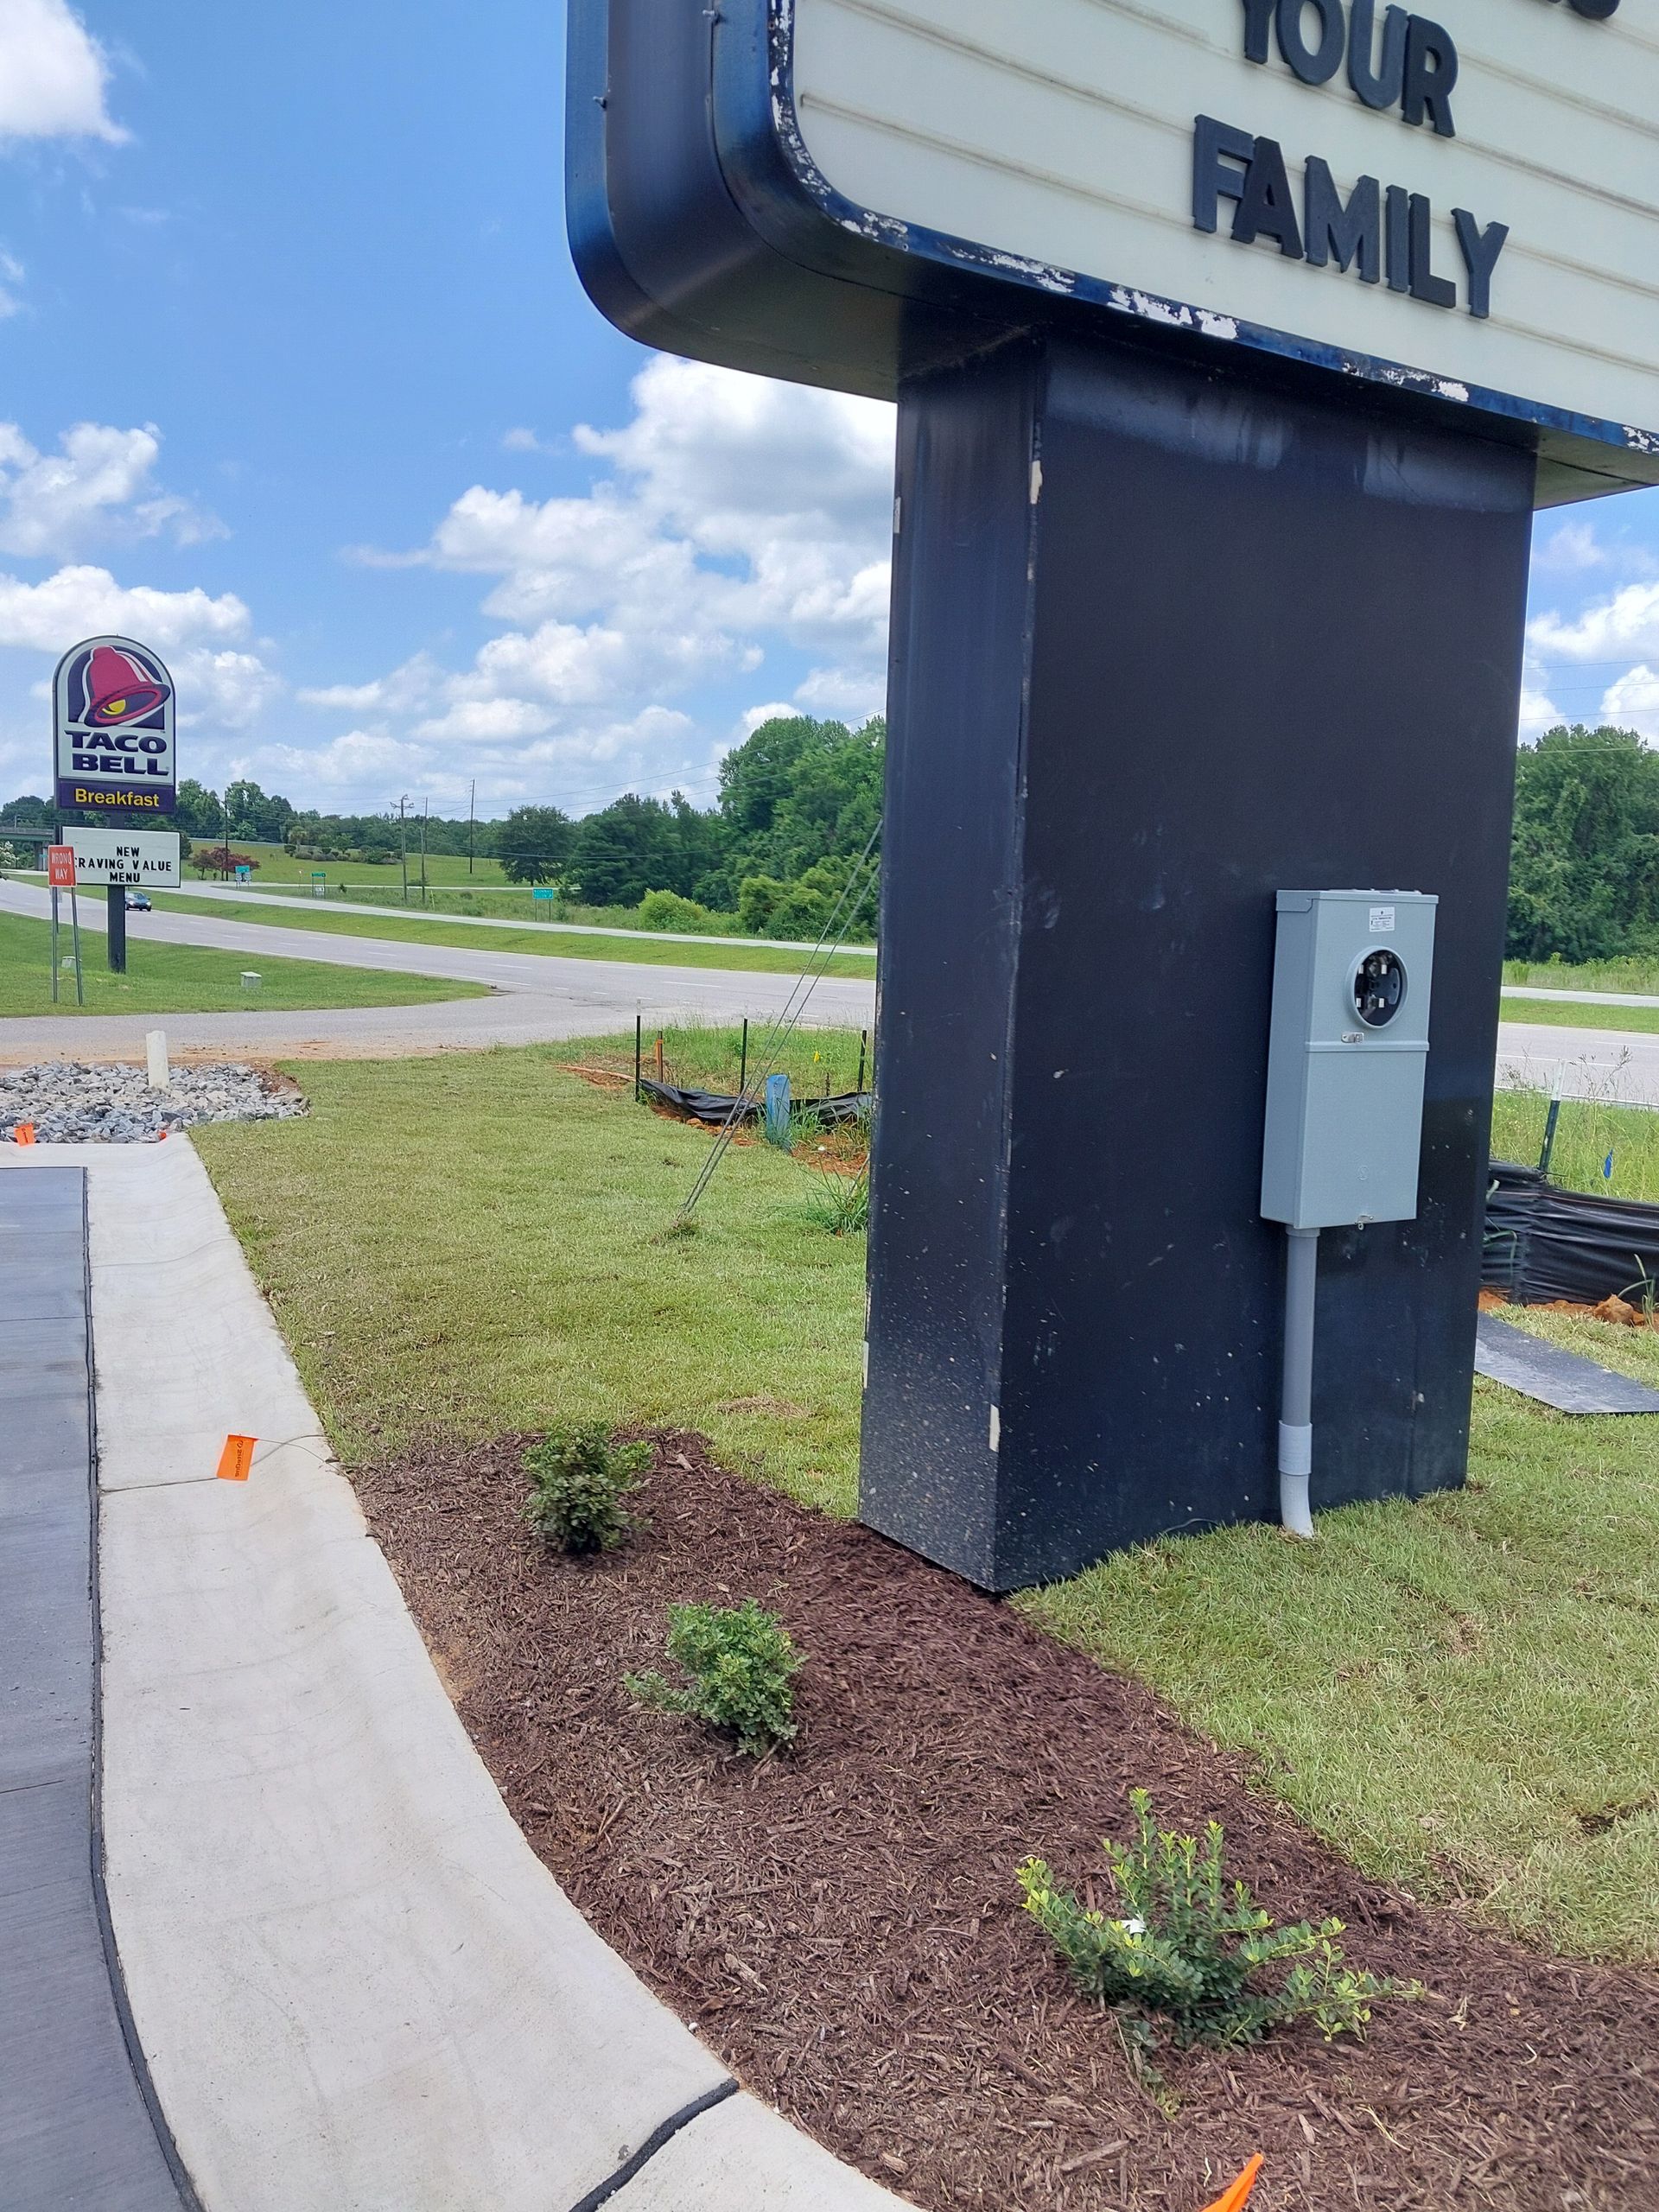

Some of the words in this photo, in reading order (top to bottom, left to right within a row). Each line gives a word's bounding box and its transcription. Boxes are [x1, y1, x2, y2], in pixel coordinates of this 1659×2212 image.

[1192, 114, 1510, 319] FAMILY
[64, 729, 167, 753] TACO
[72, 753, 169, 776] BELL
[75, 788, 160, 807] Breakfast
[116, 846, 140, 857] NEW
[133, 860, 172, 872] VALUE
[54, 868, 68, 880] WAY
[109, 872, 141, 883] MENU
